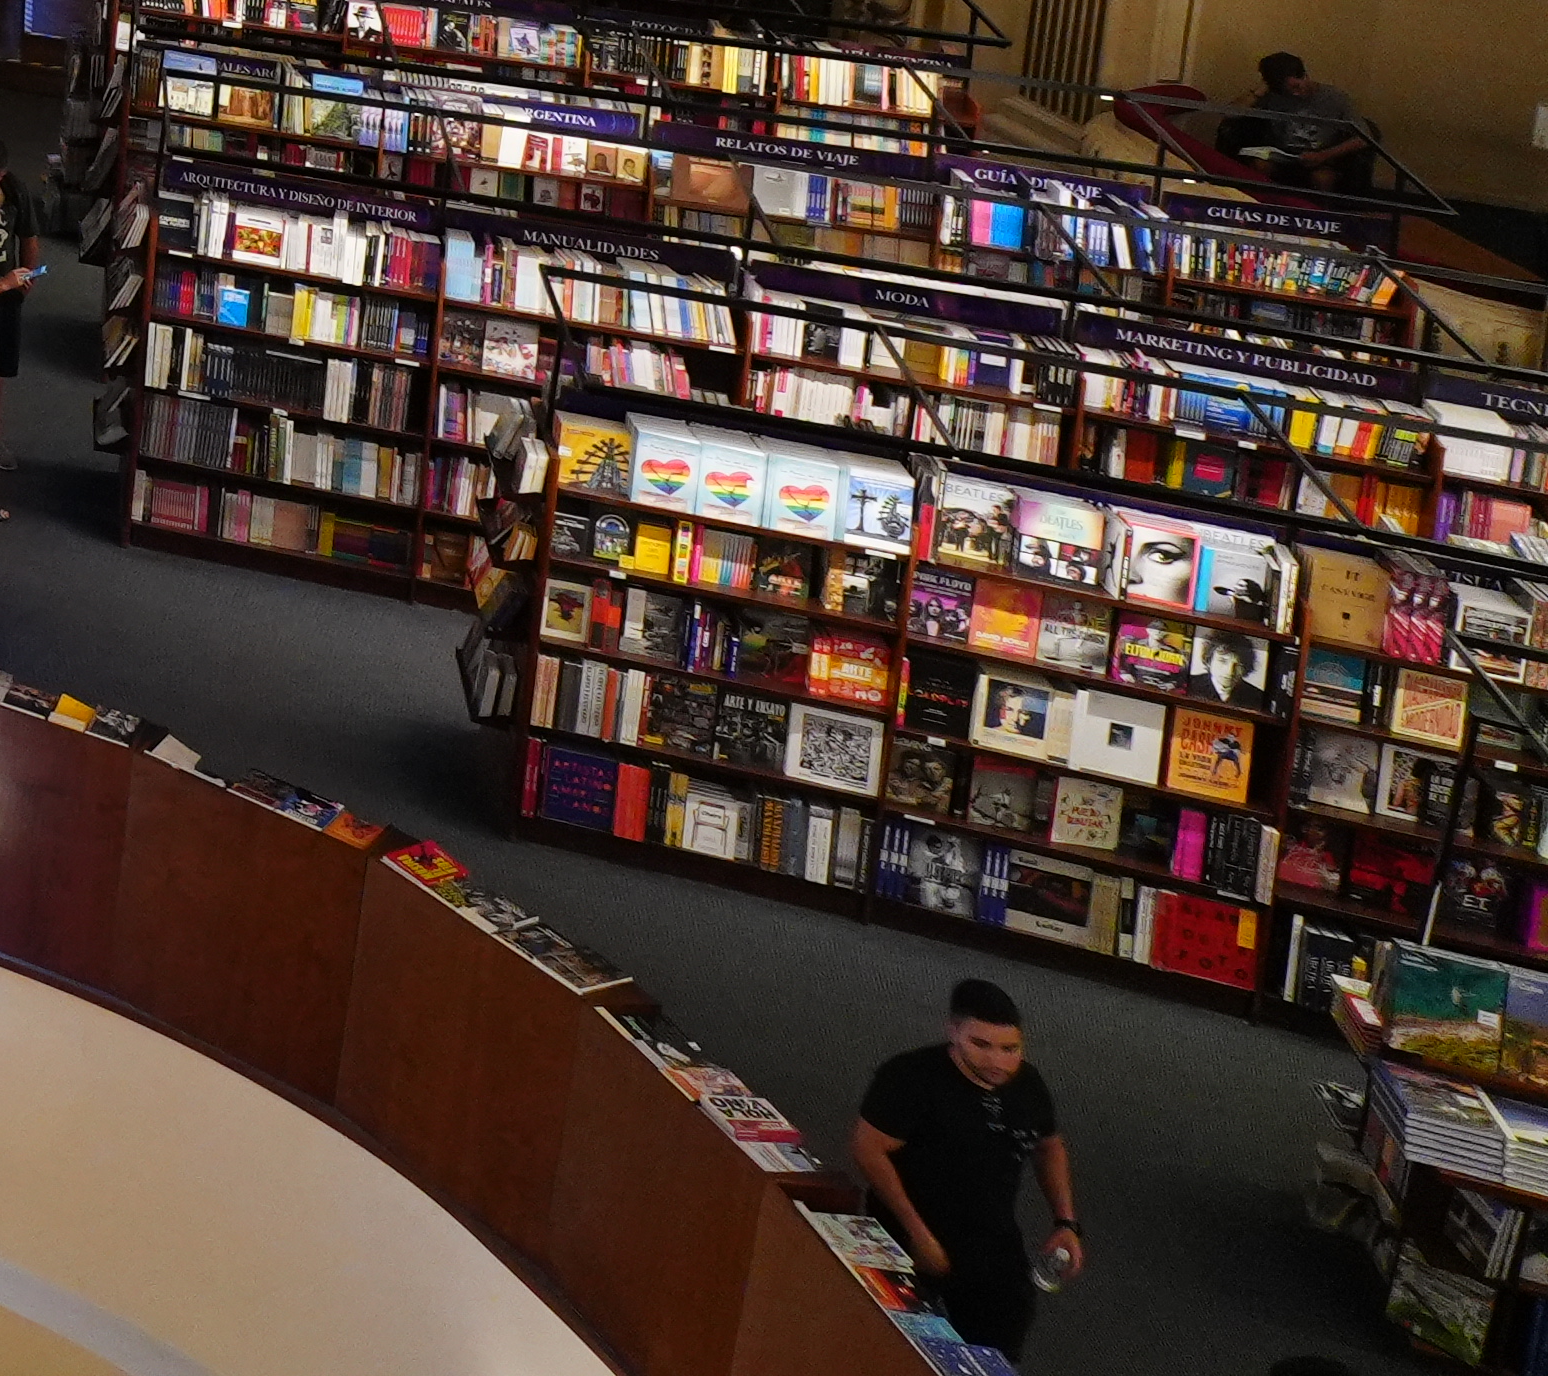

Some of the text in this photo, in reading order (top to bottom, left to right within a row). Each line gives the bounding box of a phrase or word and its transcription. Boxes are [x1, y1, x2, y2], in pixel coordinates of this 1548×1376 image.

[522, 107, 597, 128] RGENTINA
[716, 135, 860, 166] RELATOS DE VIAJE
[180, 170, 417, 223] ARQUITECTURA Y DISEÑO DE INTERIOR
[1207, 204, 1342, 235] GUÍAS DE VIAJE
[523, 229, 661, 262] MANUALIDADES
[875, 289, 930, 308] MODA
[1116, 328, 1378, 388] MARKETING Y PUBLICIDAD
[944, 482, 1006, 504] BEATLES
[1040, 509, 1084, 532] BEATLES
[1202, 528, 1266, 551] BEATLES
[938, 574, 972, 592] FLOYD
[724, 694, 744, 709] ARTE
[755, 698, 786, 718] ENSAYO
